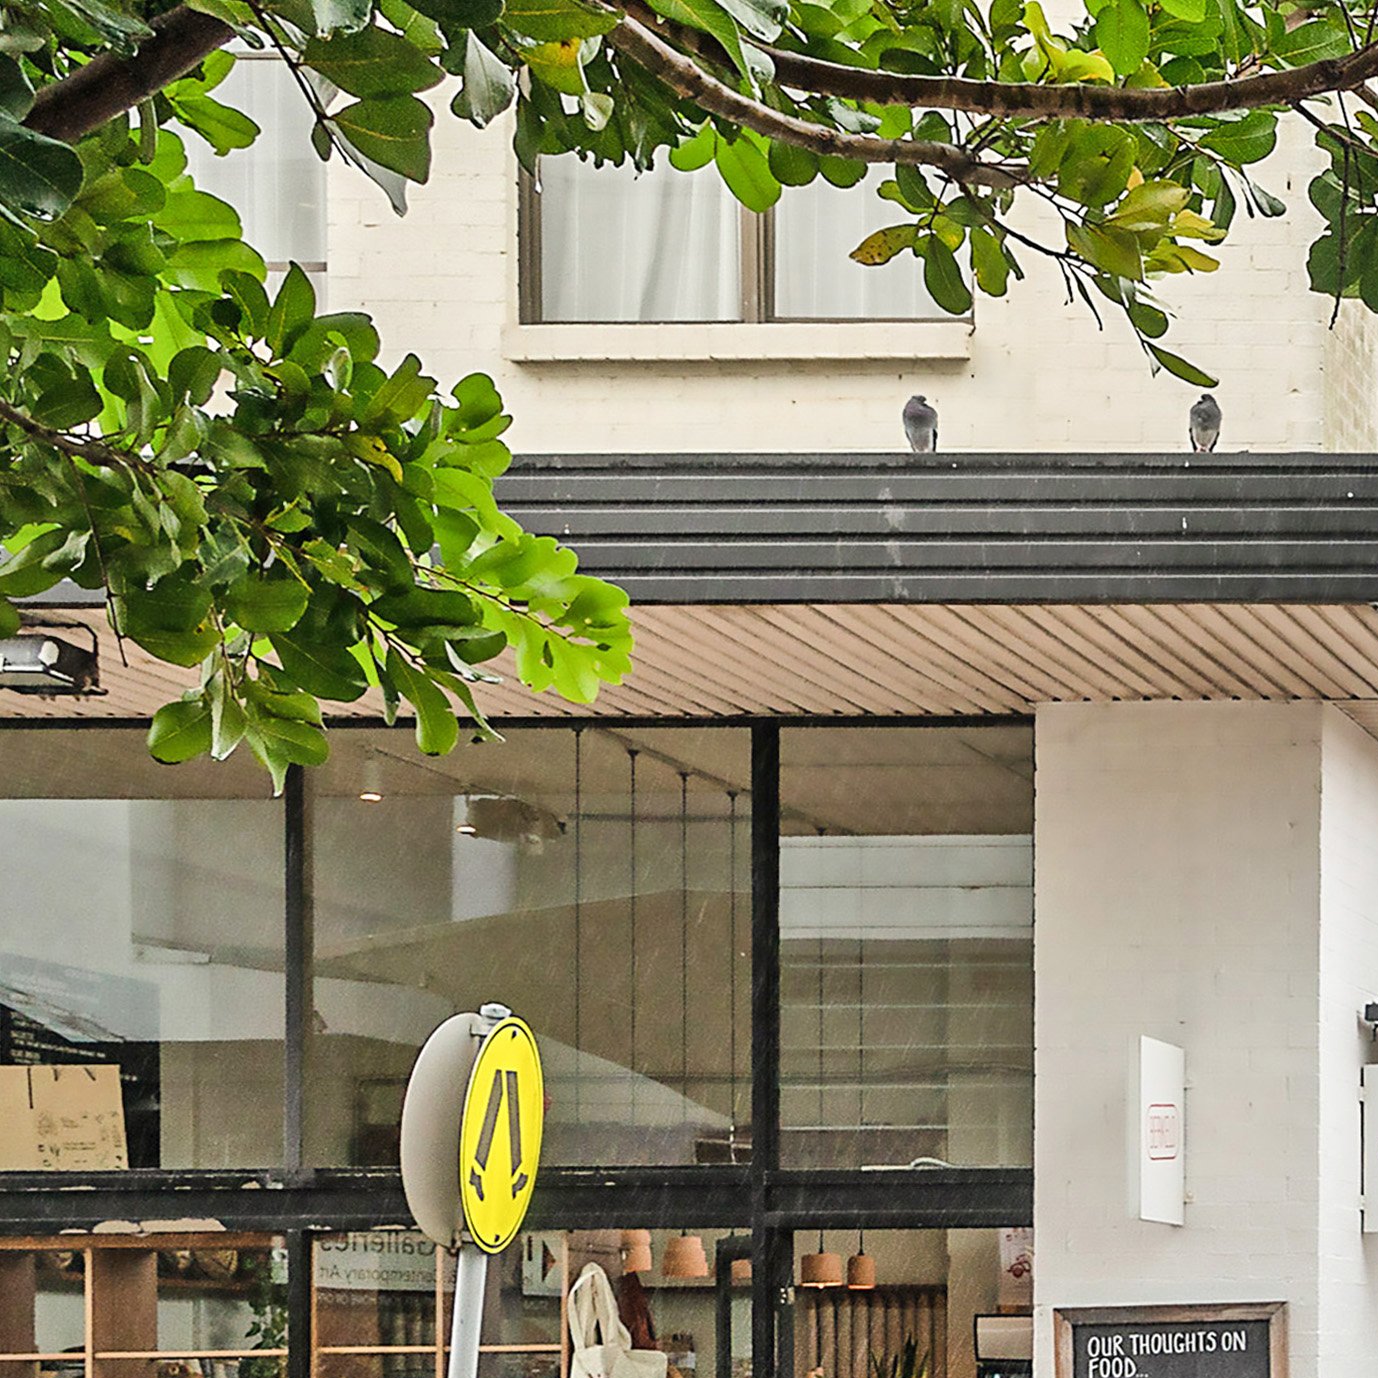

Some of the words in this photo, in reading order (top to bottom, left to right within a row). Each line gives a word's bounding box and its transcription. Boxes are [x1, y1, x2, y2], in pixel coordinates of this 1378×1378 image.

[1087, 1335, 1125, 1357] OUR
[1129, 1331, 1217, 1355] THOUGHTS
[1221, 1330, 1246, 1352] ON
